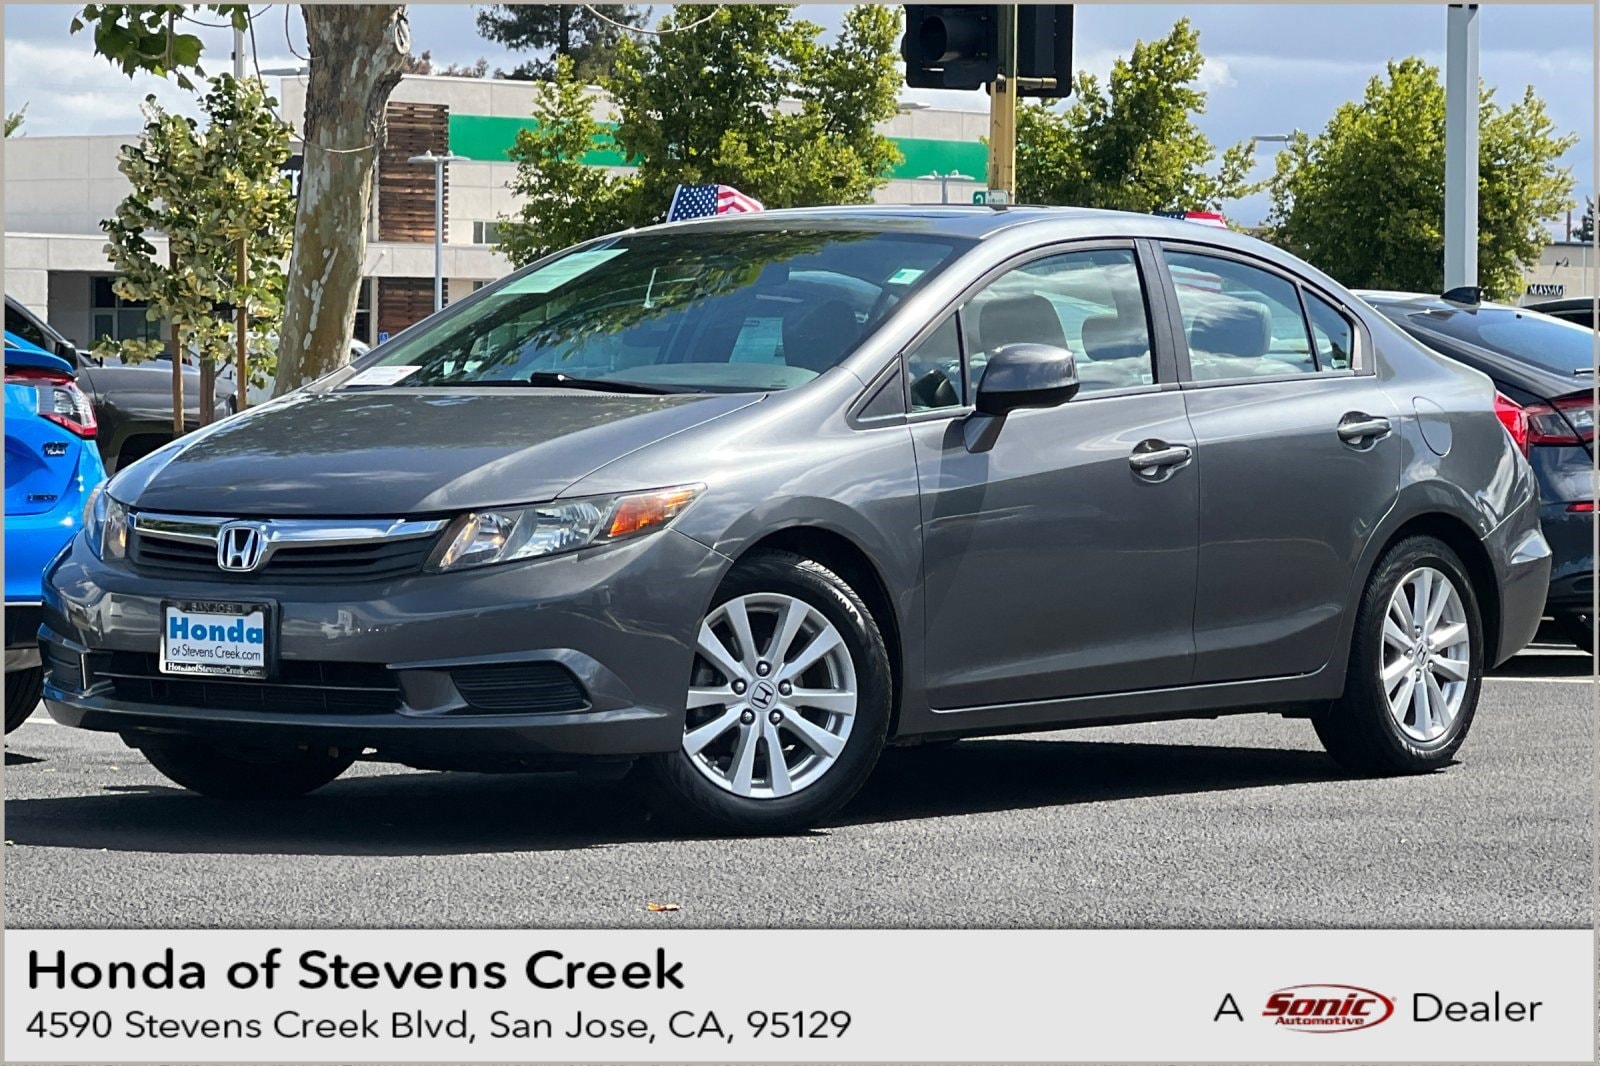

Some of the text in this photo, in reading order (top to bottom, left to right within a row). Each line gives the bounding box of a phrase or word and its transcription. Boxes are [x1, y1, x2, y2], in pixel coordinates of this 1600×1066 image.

[169, 616, 263, 644] Honda
[171, 644, 261, 660] of Stevens Creek.com
